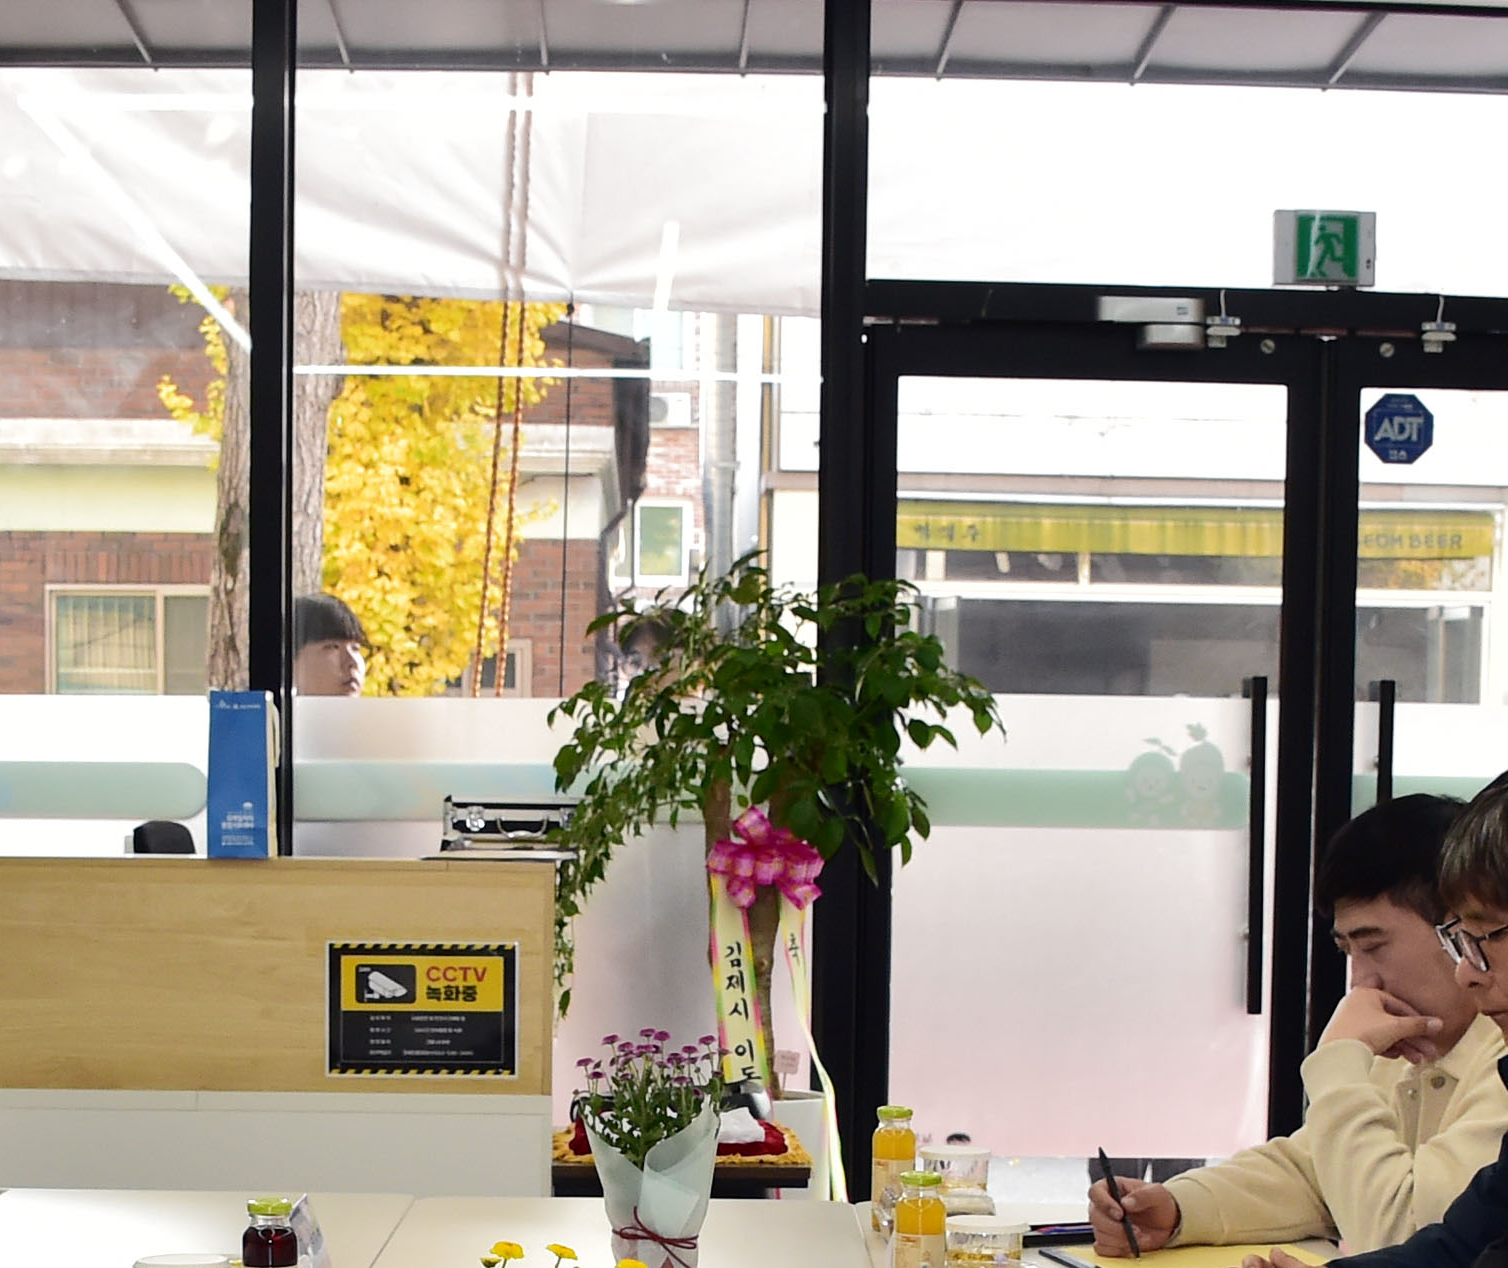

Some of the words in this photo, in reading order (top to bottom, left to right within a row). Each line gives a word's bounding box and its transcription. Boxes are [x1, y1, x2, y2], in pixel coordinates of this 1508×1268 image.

[1373, 416, 1424, 442] ADT
[1409, 533, 1462, 549] BEER
[426, 965, 488, 982] CCTV
[724, 940, 749, 1021] 김제시
[426, 985, 478, 1003] 녹화중
